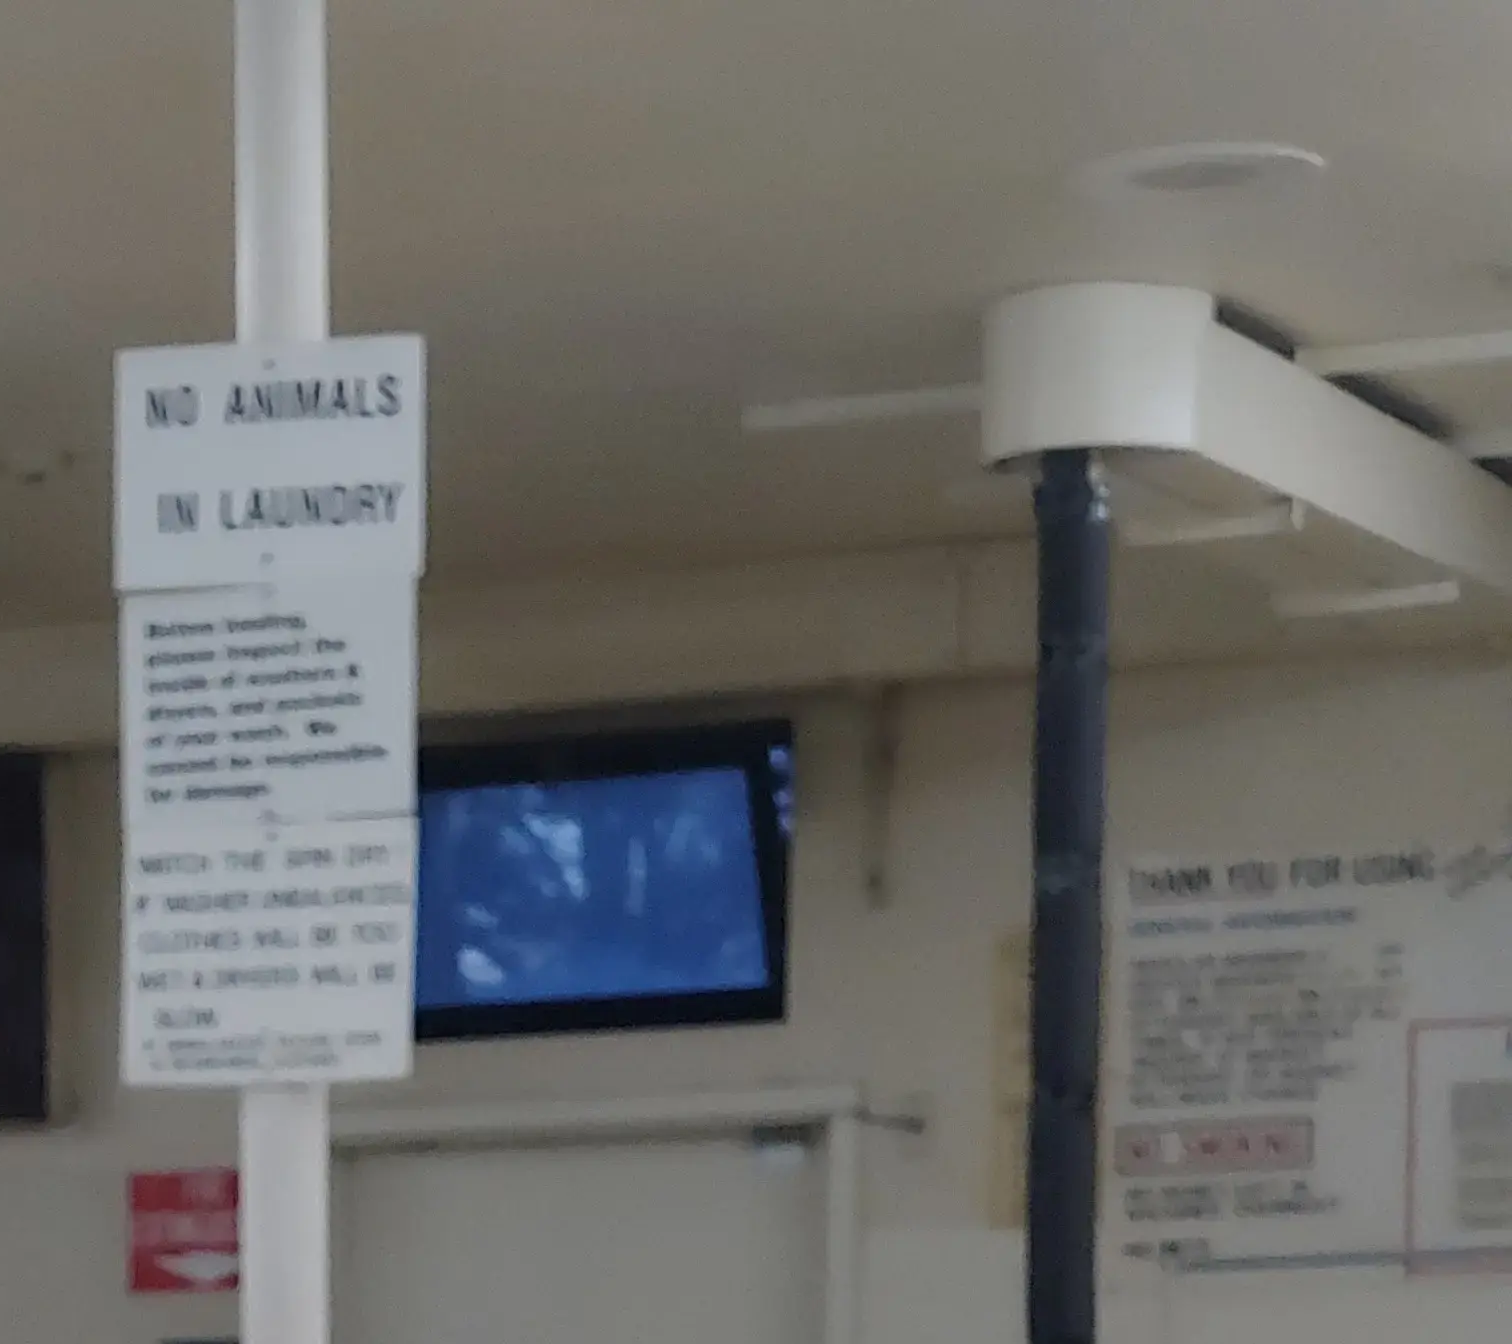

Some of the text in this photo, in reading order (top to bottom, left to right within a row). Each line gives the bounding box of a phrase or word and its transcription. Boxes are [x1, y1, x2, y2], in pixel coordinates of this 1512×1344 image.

[145, 373, 402, 428] NO ANIMALS
[157, 483, 405, 533] IN LAUNDRY
